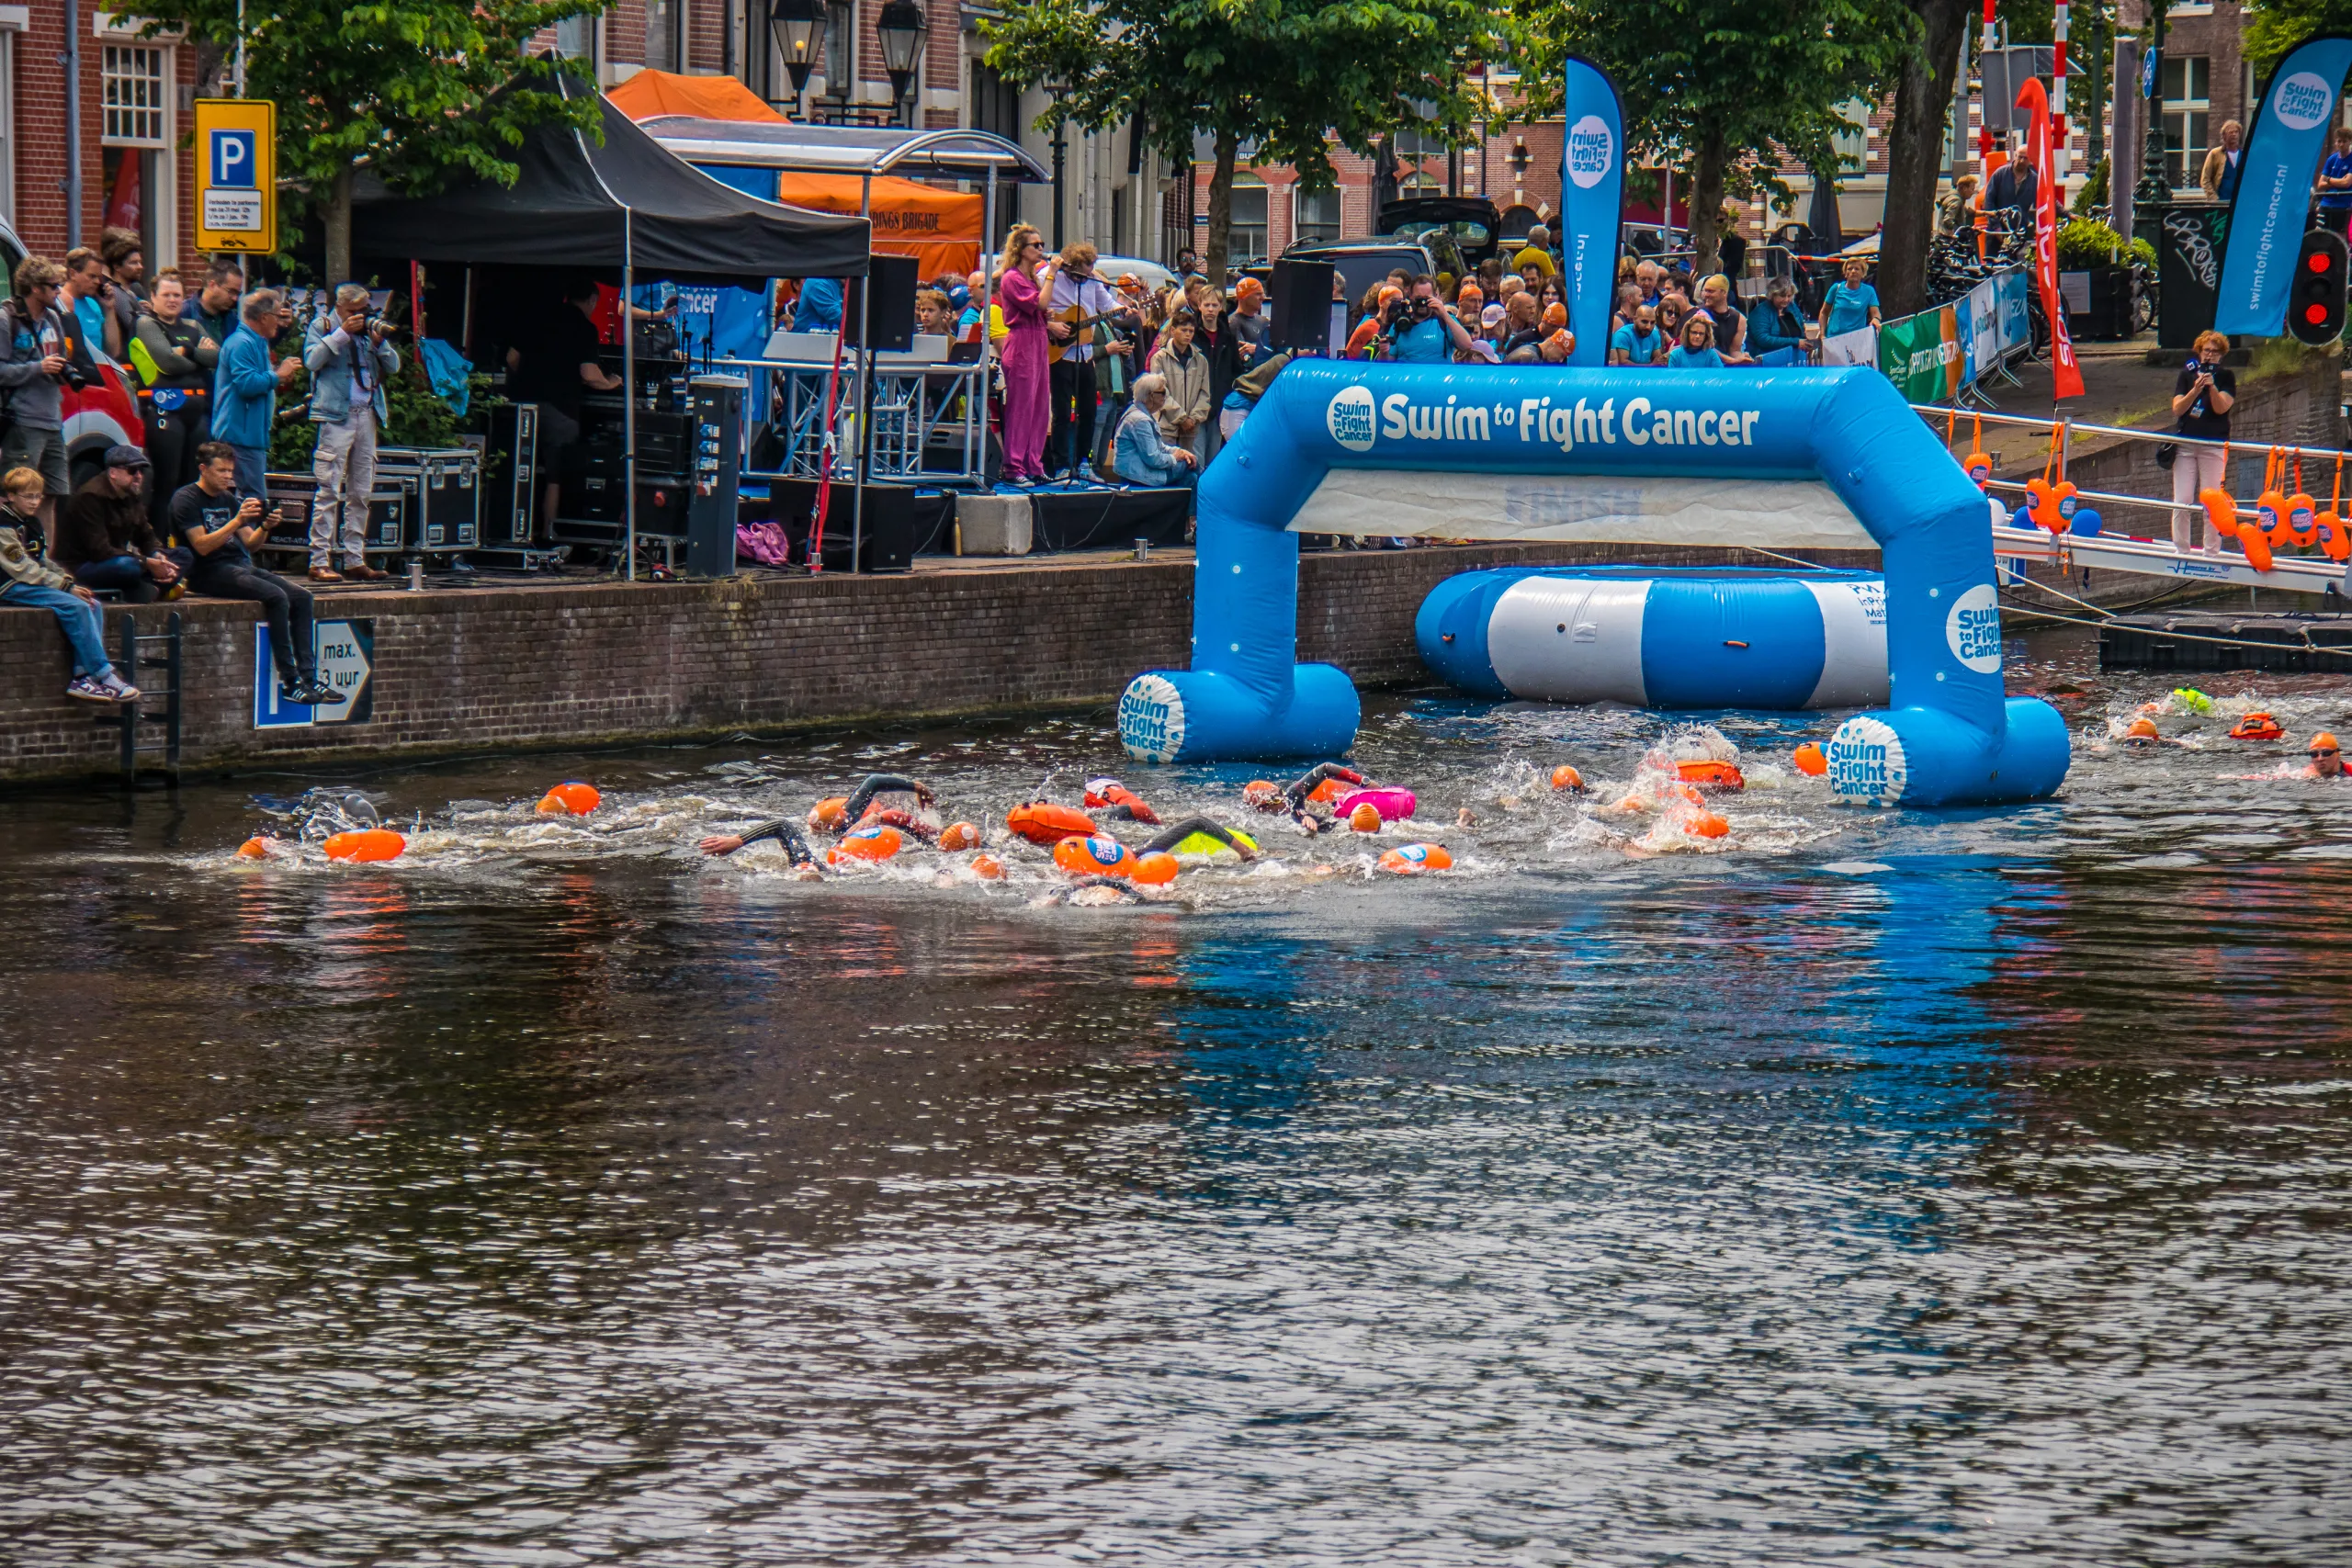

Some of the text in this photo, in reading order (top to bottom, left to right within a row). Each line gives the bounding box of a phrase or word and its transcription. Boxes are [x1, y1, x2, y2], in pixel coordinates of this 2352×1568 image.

[2284, 83, 2326, 101] Swim
[2279, 102, 2321, 120] Cancer
[2290, 95, 2324, 113] Fight
[220, 137, 245, 181] P
[902, 211, 940, 230] BRIGADE
[2250, 164, 2289, 310] swimtofightcancer.nl
[1333, 400, 1371, 419] Swim
[1333, 415, 1371, 432] to Fight
[1382, 393, 1760, 453] Swim to Fight Cancer
[1335, 428, 1373, 442] Cancer
[1857, 597, 1886, 606] InPri
[1959, 631, 1973, 641] to
[323, 644, 356, 660] max.
[322, 669, 359, 687] 3 uur
[1121, 694, 1169, 720] Swim
[1125, 713, 1167, 739] Fight
[1830, 739, 1886, 763] Swim
[1828, 761, 1888, 783] to Fight
[1830, 776, 1888, 796] Cancer
